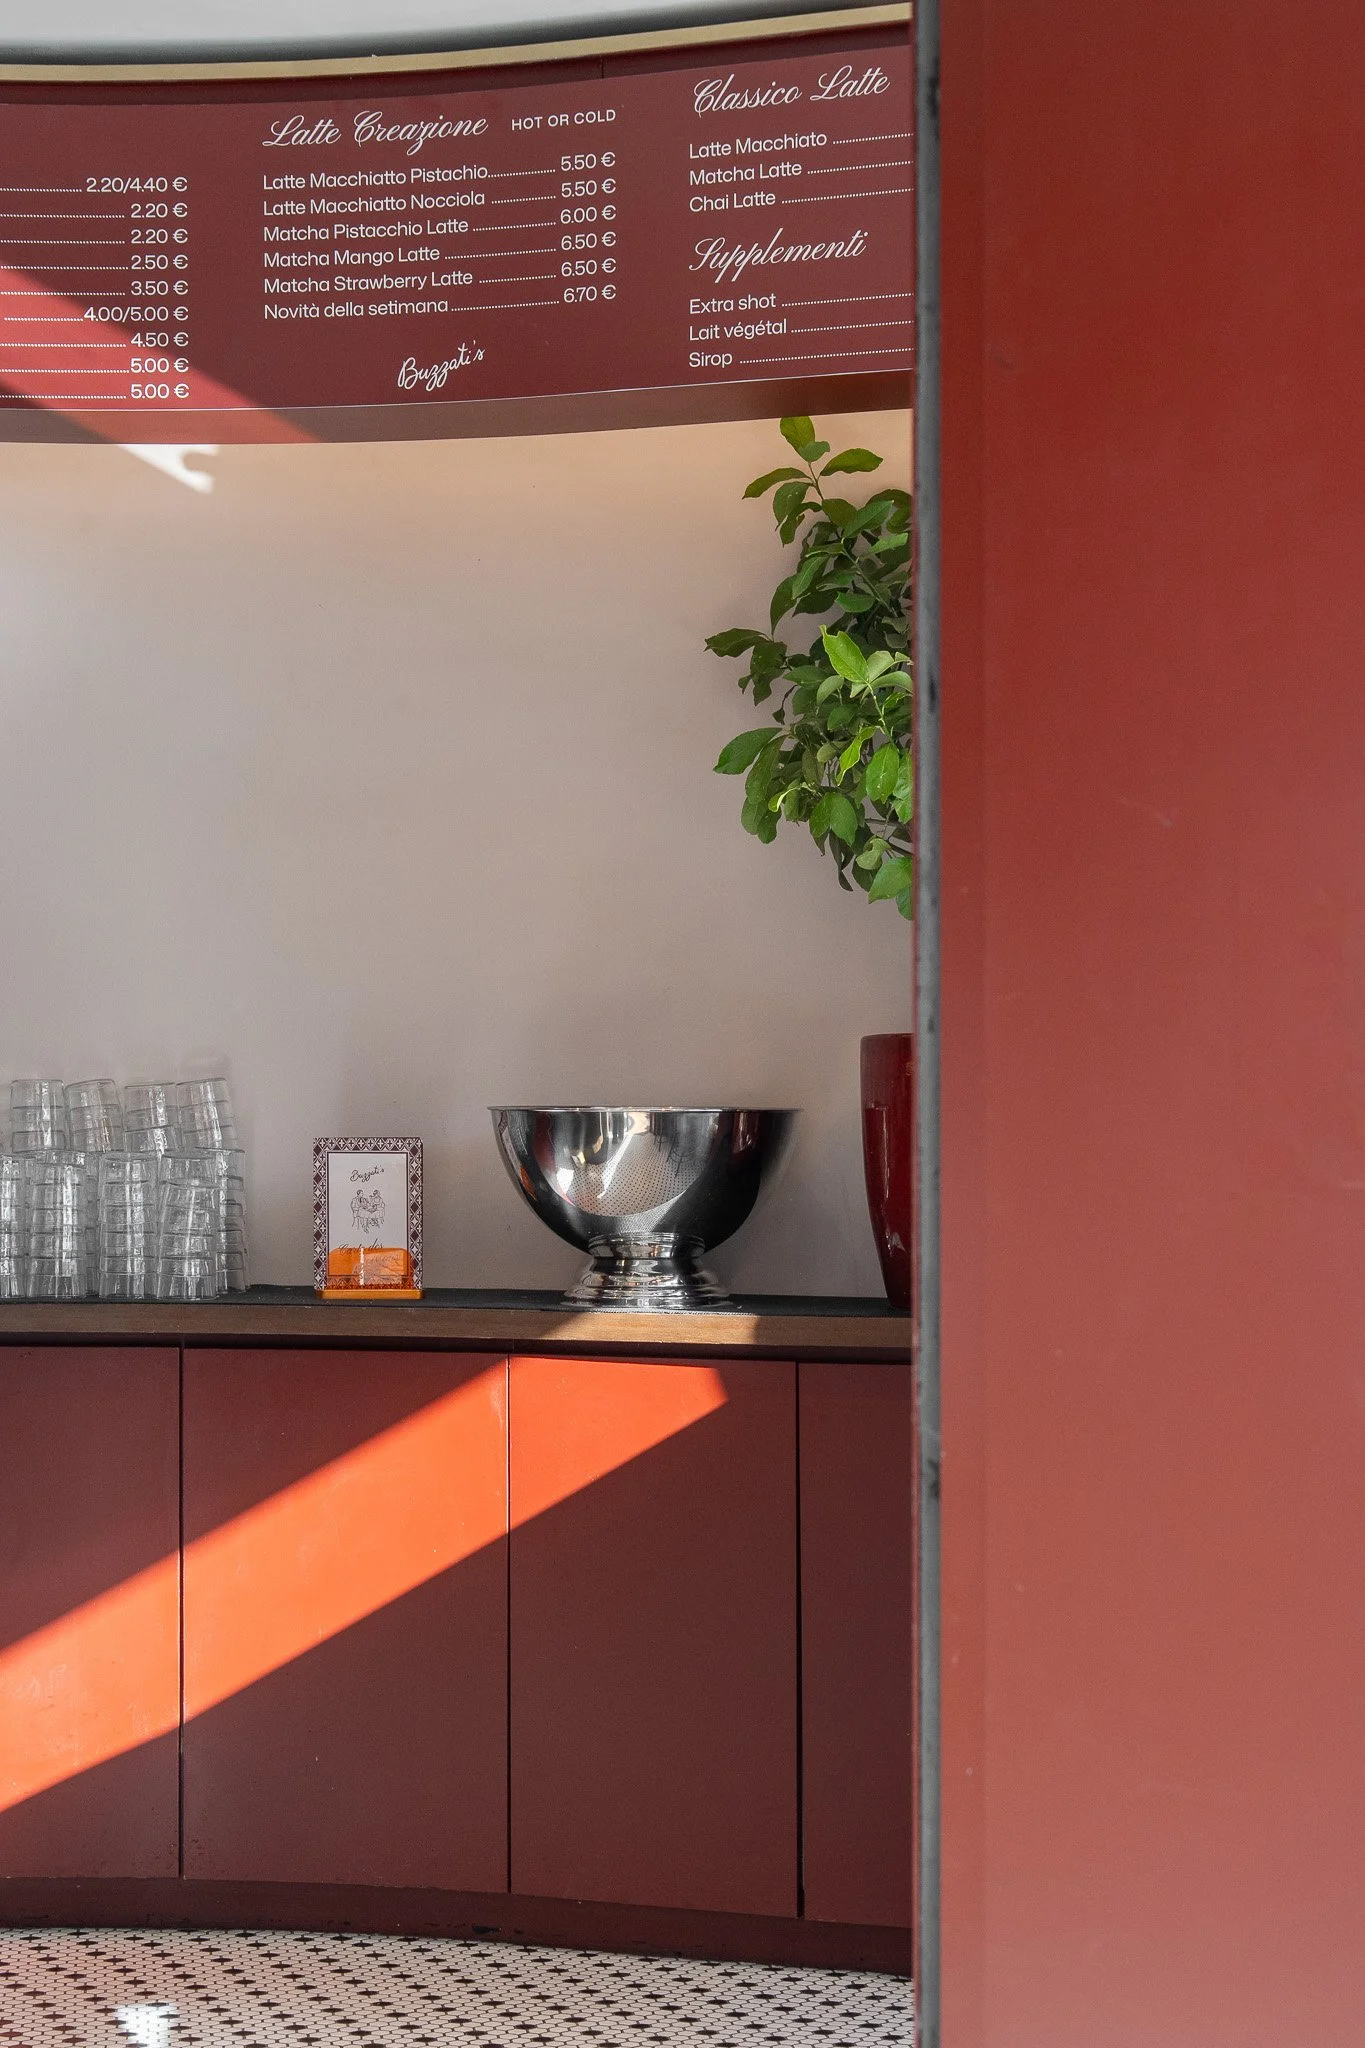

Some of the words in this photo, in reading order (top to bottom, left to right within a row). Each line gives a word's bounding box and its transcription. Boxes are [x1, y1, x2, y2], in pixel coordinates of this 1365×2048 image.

[693, 73, 803, 118] Classico
[809, 64, 891, 101] Latte
[511, 117, 544, 131] HOT
[547, 113, 570, 128] OR
[573, 108, 617, 125] COLD
[261, 114, 342, 147] Latte
[353, 110, 489, 157] Creazione
[688, 140, 732, 160] Latte
[735, 131, 828, 155] Macchiato
[263, 173, 307, 190] Latte
[309, 167, 407, 189] Macchiatto
[410, 164, 489, 184] Pistachio
[560, 153, 598, 172] 5.50
[600, 151, 616, 168] €
[689, 164, 755, 187] Matcha
[759, 161, 803, 180] Latte
[172, 176, 188, 193] €
[263, 199, 307, 216] Latte
[309, 193, 407, 215] Macchiatto
[410, 190, 486, 210] Nocciola
[561, 179, 599, 198] 5.50
[601, 177, 617, 194] €
[130, 202, 170, 219] 2.20
[172, 202, 188, 219] €
[688, 195, 729, 213] Chai
[733, 190, 777, 209] Latte
[263, 223, 330, 243] Matcha
[333, 219, 424, 241] Pistacchio
[426, 218, 470, 236] Latte
[560, 206, 598, 226] 6.00
[601, 203, 617, 220] €
[130, 228, 170, 245] 2.20
[172, 228, 188, 245] €
[263, 250, 330, 268] Matcha
[334, 248, 395, 268] Mango
[397, 246, 441, 263] Latte
[560, 232, 598, 252] 6.50
[601, 230, 617, 247] €
[688, 227, 868, 284] Supplementi
[130, 254, 170, 271] 2.50
[173, 254, 189, 271] €
[263, 275, 330, 294] Matcha
[333, 272, 429, 293] Strawberry
[430, 270, 474, 287] Latte
[560, 259, 598, 278] 6.50
[601, 257, 617, 274] €
[130, 280, 170, 297] 3.50
[173, 279, 189, 296] €
[173, 305, 189, 322] €
[264, 300, 320, 320] Novità
[323, 301, 366, 319] della
[601, 283, 617, 300] €
[689, 297, 735, 315] Extra
[737, 292, 778, 310] shot
[130, 331, 170, 349] 4.50
[173, 331, 189, 348] €
[689, 324, 721, 342] Lait
[723, 317, 788, 341] végétal
[130, 357, 170, 374] 5.00
[173, 357, 189, 374] €
[397, 340, 486, 393] Buzzati's
[688, 351, 734, 369] Sirop
[130, 383, 170, 400] 5.00
[174, 382, 190, 399] €
